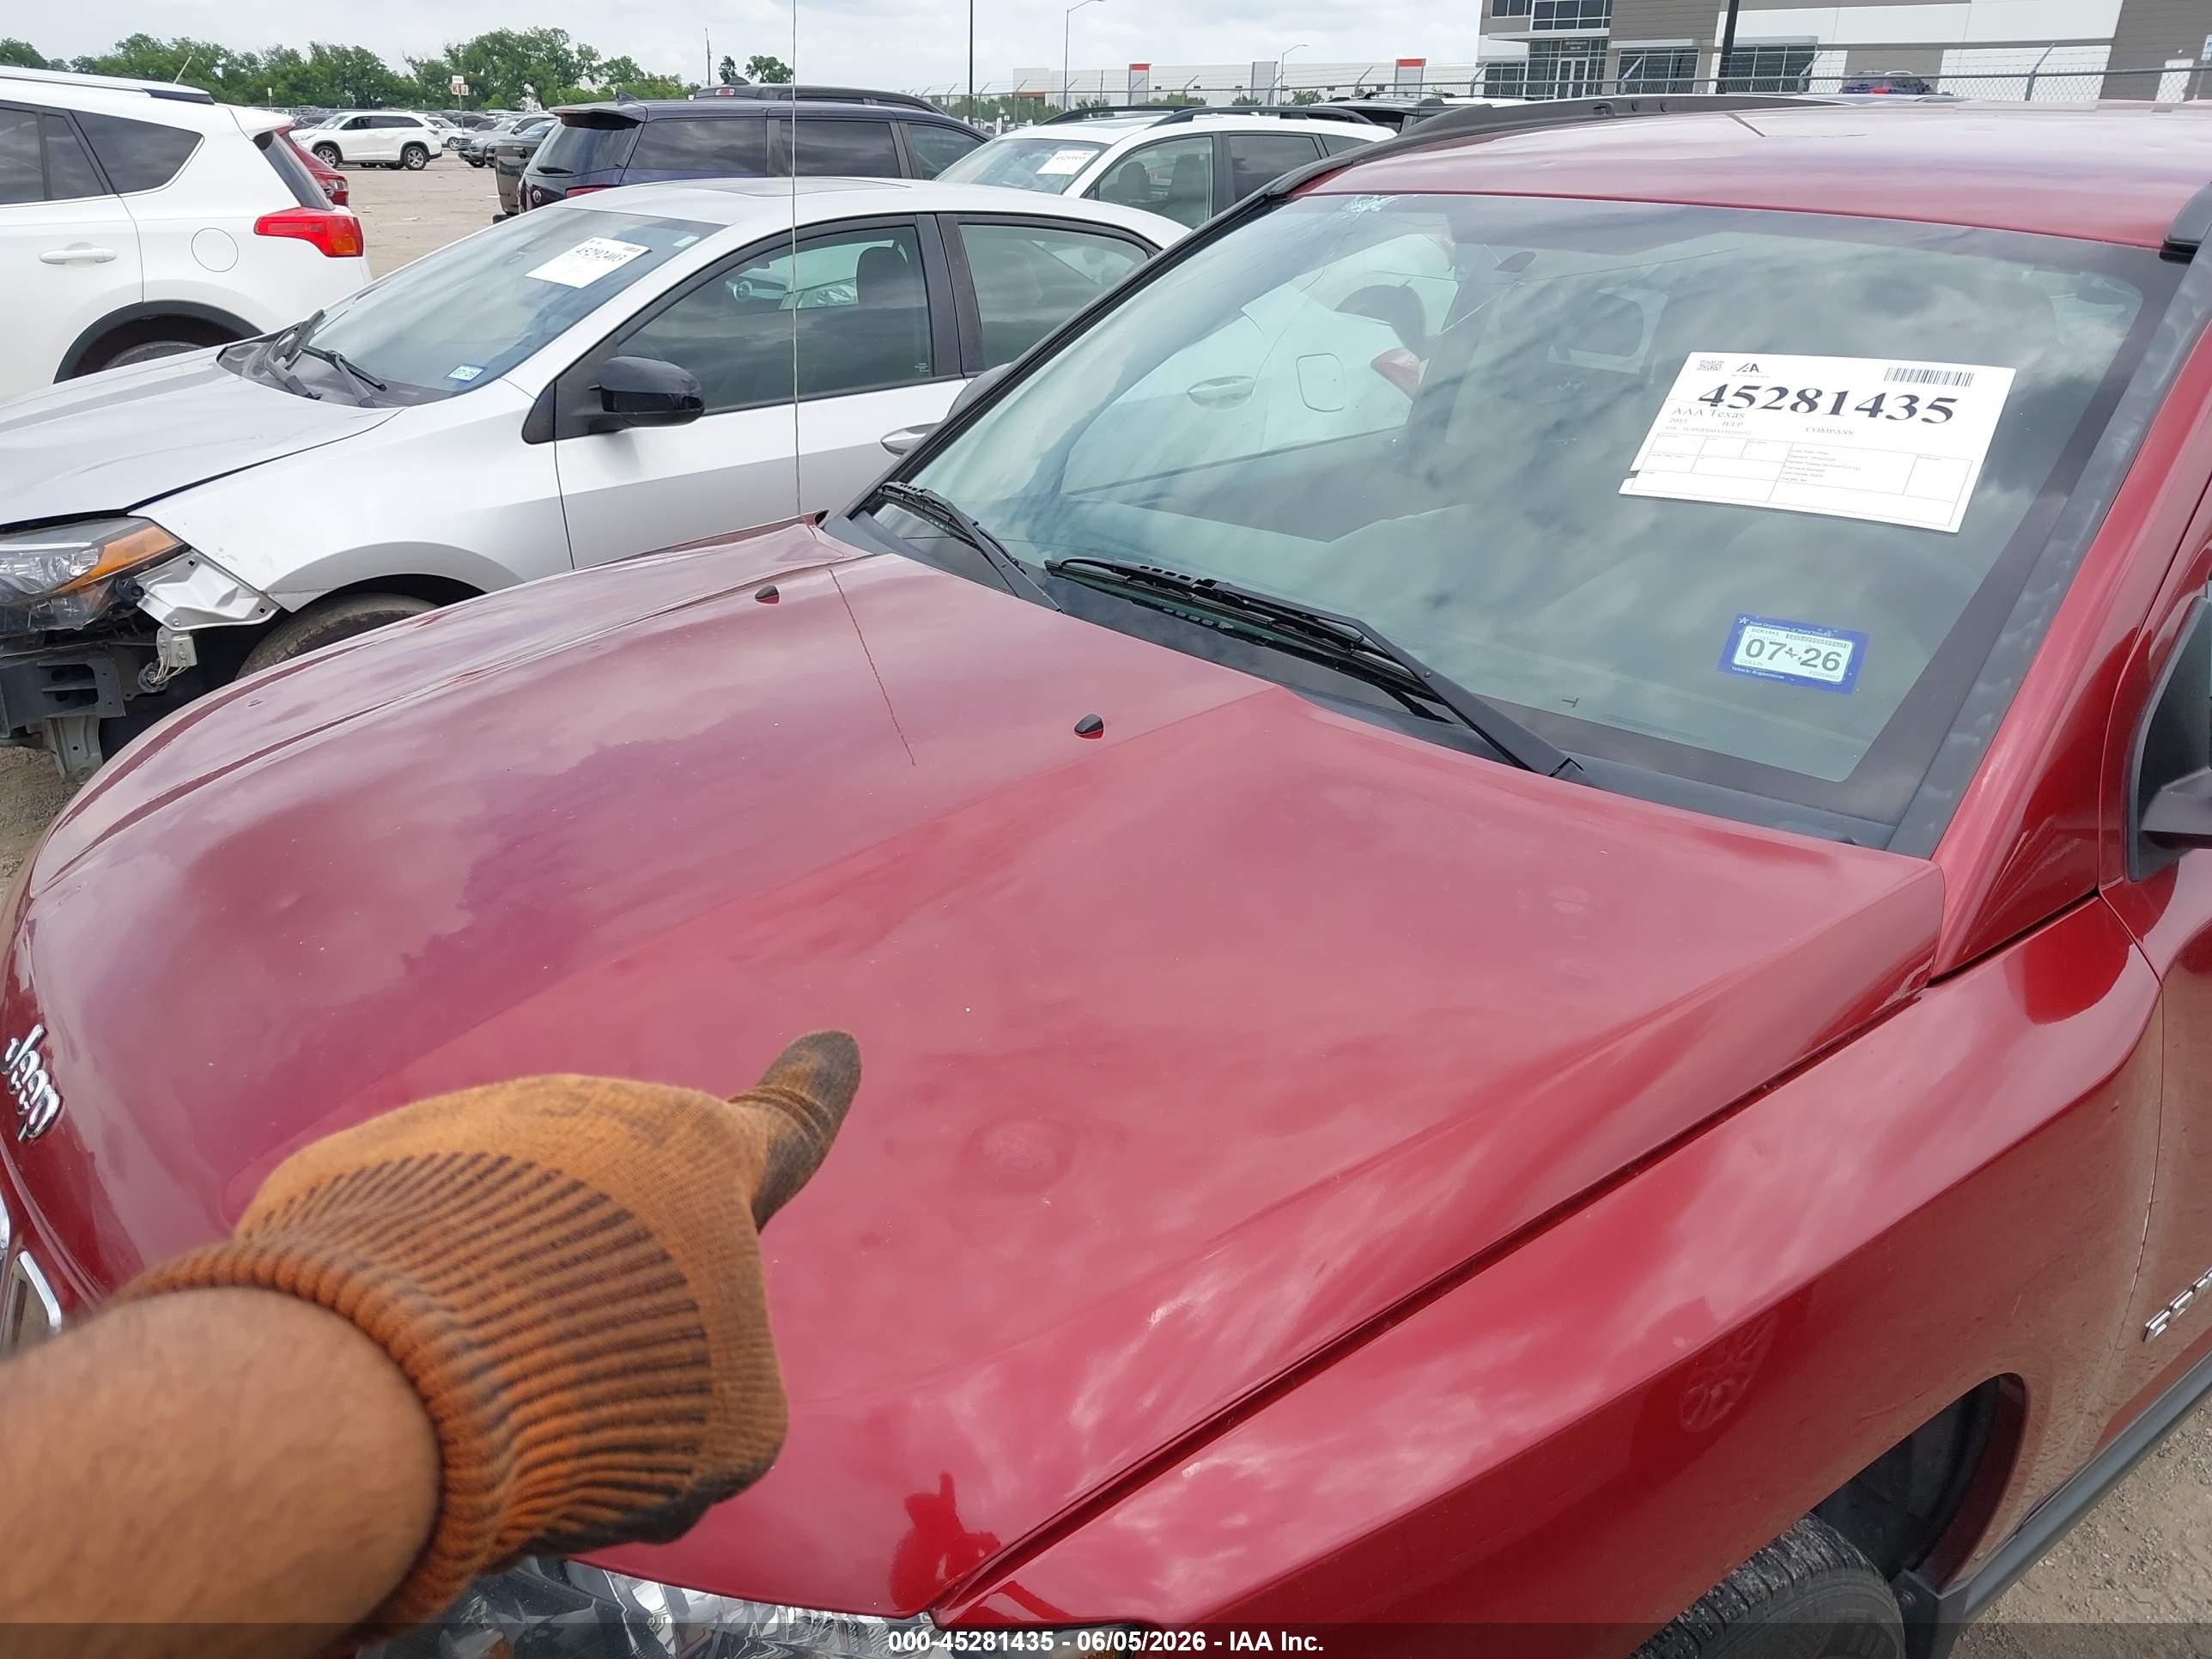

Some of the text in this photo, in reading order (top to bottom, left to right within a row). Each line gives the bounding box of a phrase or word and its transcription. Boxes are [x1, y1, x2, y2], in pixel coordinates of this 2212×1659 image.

[1671, 407, 1745, 418] AAA Texas
[1698, 384, 1959, 424] 45281435
[1746, 639, 1842, 672] 07 26
[4, 1024, 61, 1141] Jeep
